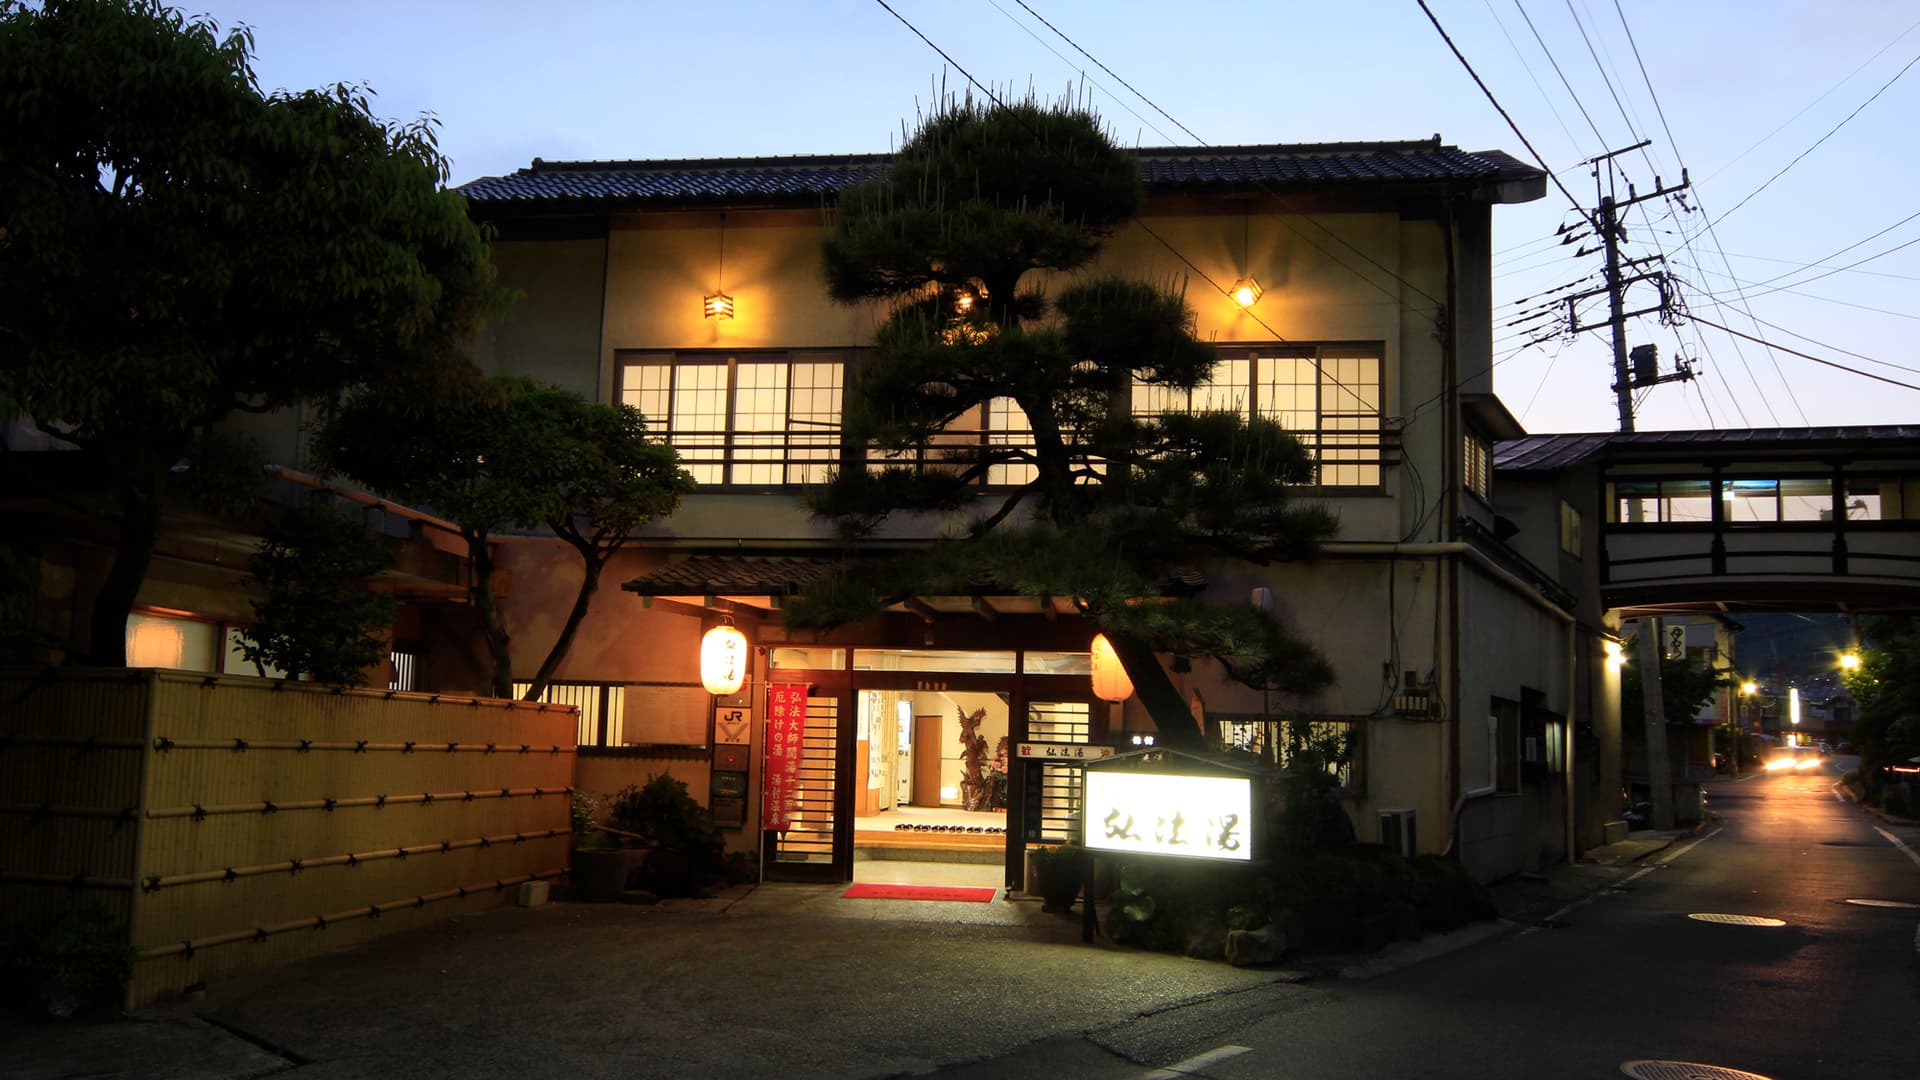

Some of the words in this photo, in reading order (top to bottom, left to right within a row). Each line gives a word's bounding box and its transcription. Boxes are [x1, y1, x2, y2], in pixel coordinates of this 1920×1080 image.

[724, 711, 743, 722] JR
[772, 690, 786, 757] 厄除けの湯
[1046, 746, 1084, 758] 弘法湯
[1102, 805, 1241, 852] 弘法湯
